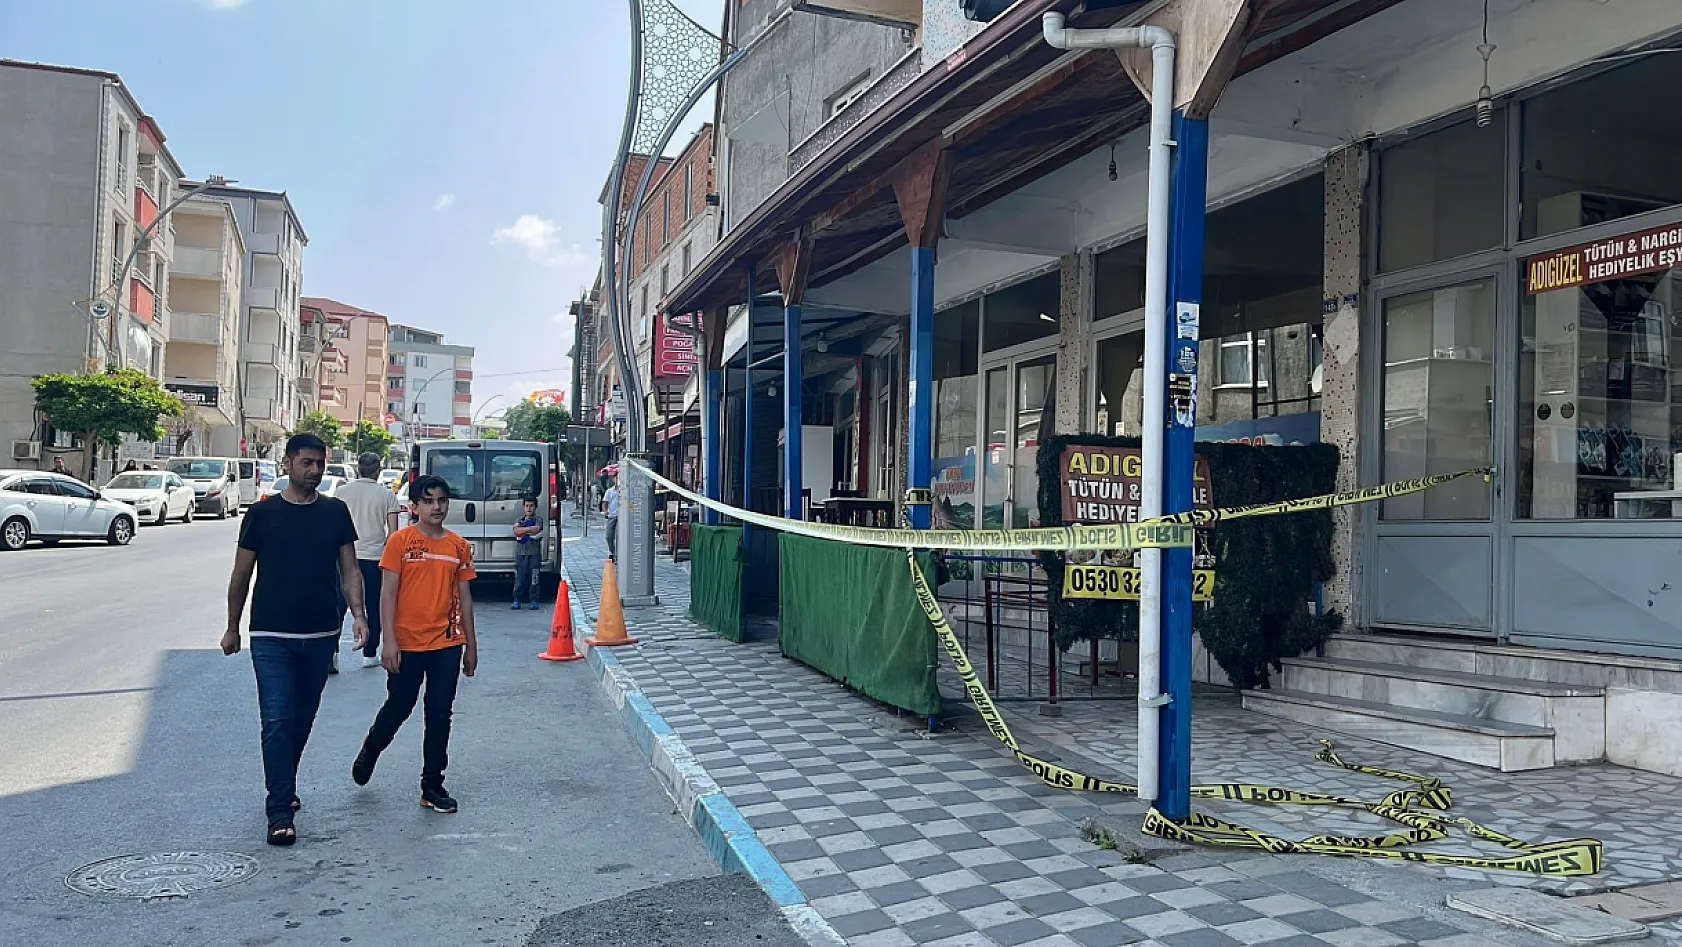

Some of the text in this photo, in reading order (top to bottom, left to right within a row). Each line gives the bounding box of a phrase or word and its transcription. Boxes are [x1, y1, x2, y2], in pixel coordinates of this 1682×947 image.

[1584, 240, 1624, 263] TÜTÜN
[1627, 239, 1638, 254] &
[1529, 252, 1584, 292] ADIGÜZEL
[1068, 478, 1124, 500] TÜTÜN
[1076, 501, 1142, 523] HEDİYE
[1071, 568, 1119, 592] 0530
[1022, 757, 1074, 788] POLİS
